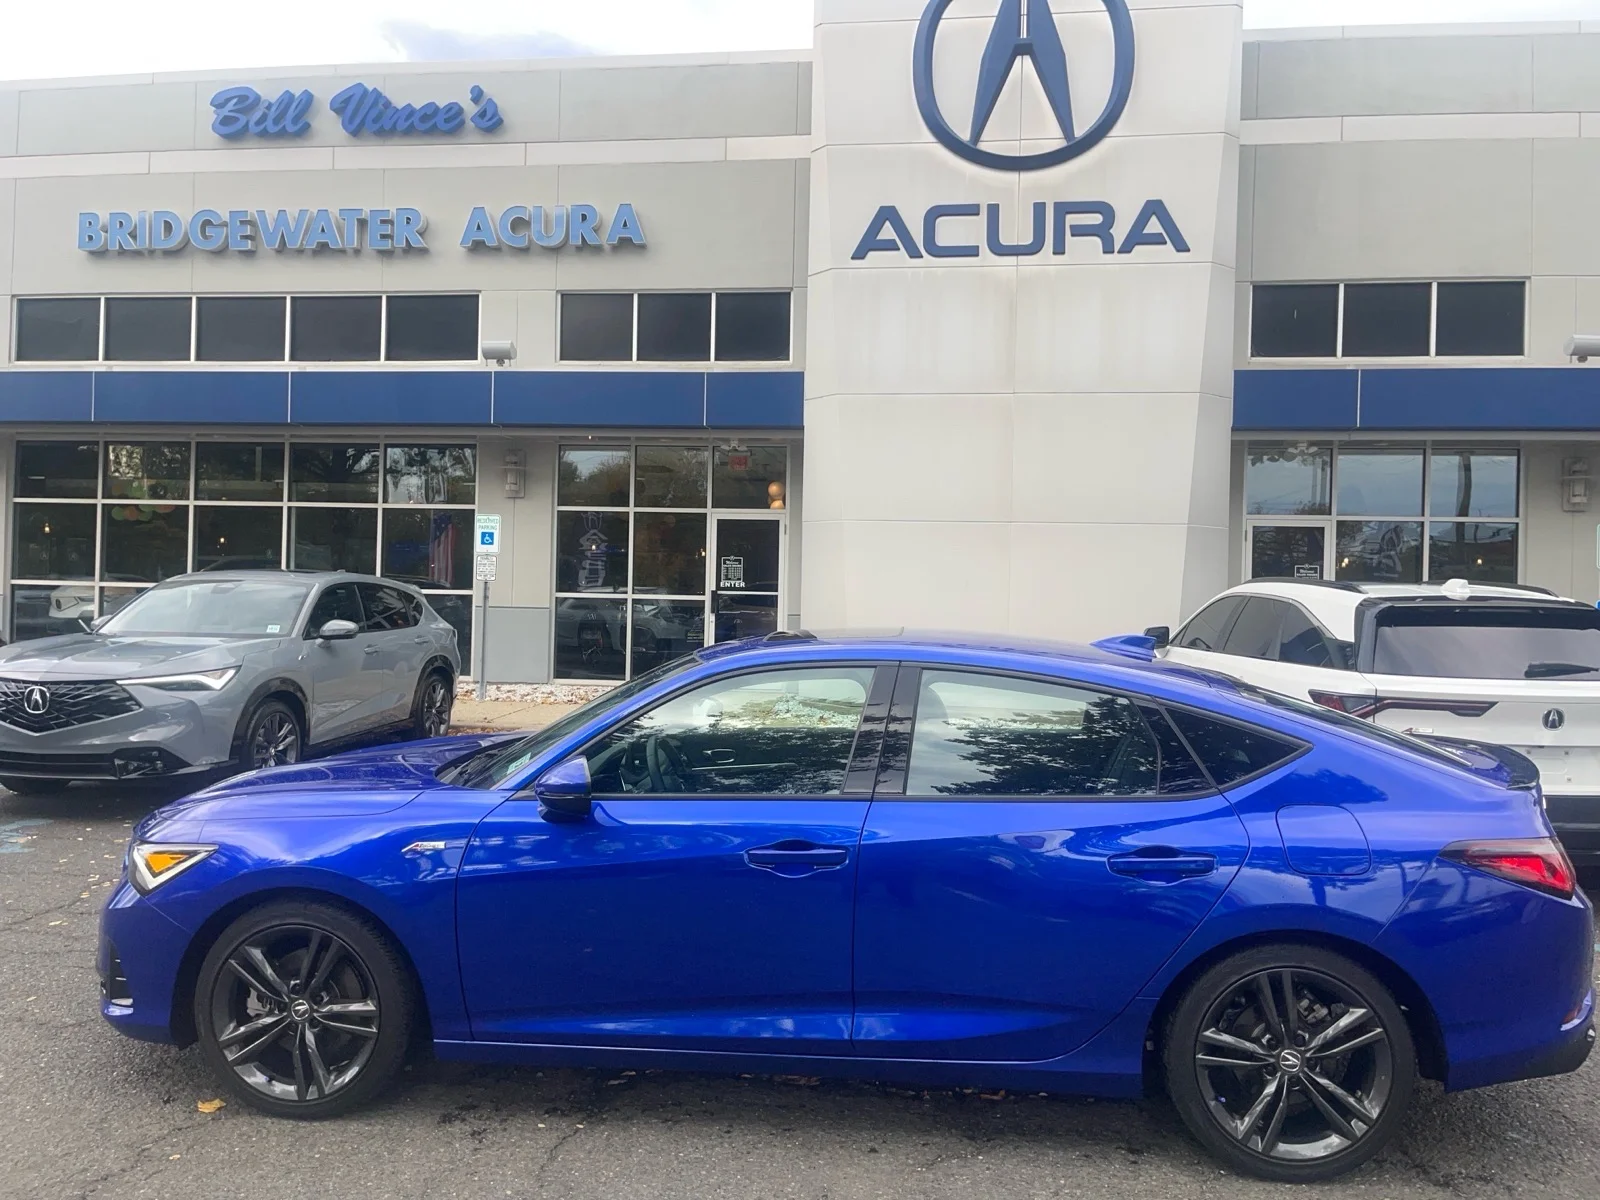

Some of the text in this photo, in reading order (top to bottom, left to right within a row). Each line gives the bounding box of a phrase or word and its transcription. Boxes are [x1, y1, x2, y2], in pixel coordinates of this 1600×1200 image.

[209, 82, 504, 140] Bill Vince's
[77, 202, 648, 254] BRIDGEWATER ACURA
[851, 198, 1190, 260] ACURA
